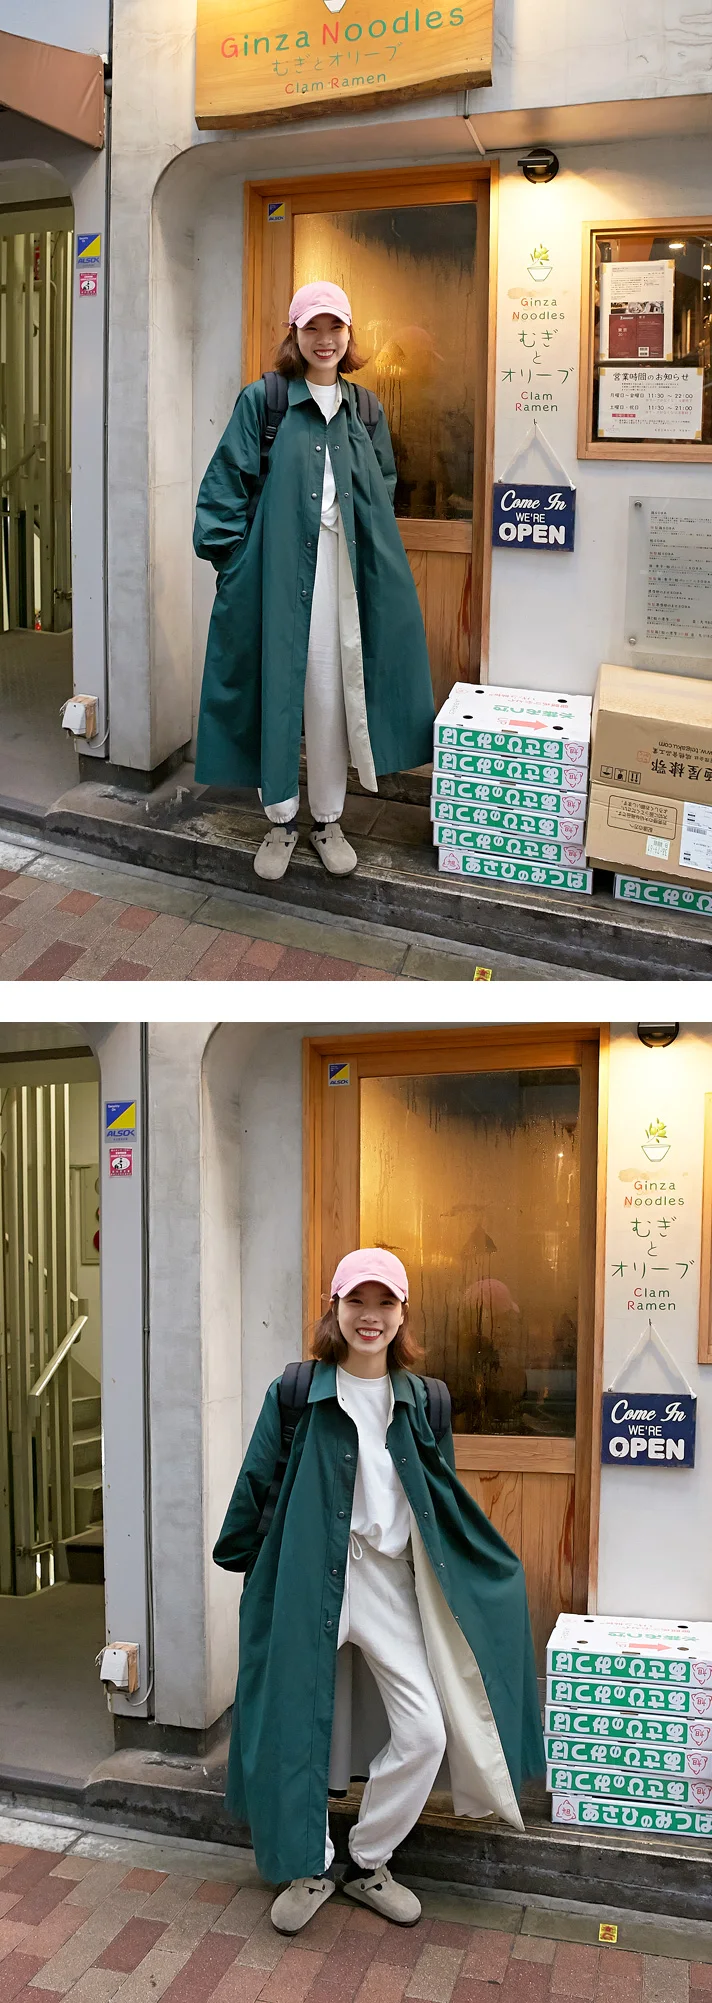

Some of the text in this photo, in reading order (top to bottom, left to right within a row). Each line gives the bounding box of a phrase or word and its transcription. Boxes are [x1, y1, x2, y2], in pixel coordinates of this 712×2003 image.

[221, 7, 465, 58] Ginza Noodles
[272, 42, 403, 76] むぎとオリーブ
[285, 73, 387, 94] Clam Ramen
[520, 298, 558, 307] Ginza
[512, 311, 565, 321] Noodles
[518, 329, 559, 348] むぎ
[533, 351, 542, 365] と
[501, 367, 575, 384] オリーブ
[613, 372, 689, 381] 営業時間のお知らせ
[521, 391, 553, 401] Clam
[515, 403, 558, 412] Ramen
[500, 490, 567, 511] Come In
[515, 512, 546, 523] WE'RE
[499, 522, 566, 545] OPEN
[441, 727, 560, 759] あさひのみつば
[441, 752, 559, 785] あさひのみつば
[439, 779, 557, 811] あさひのみつば
[438, 802, 555, 836] あさひのみつば
[441, 828, 558, 860] あさひのみつば
[465, 858, 584, 889] あさひのみつば
[107, 1129, 135, 1137] ALSOK
[634, 1181, 676, 1191] Ginza
[624, 1196, 685, 1206] Noodles
[630, 1216, 677, 1237] むぎ
[647, 1241, 658, 1257] と
[611, 1259, 695, 1279] オリーブ
[633, 1287, 670, 1298] Clam
[627, 1300, 676, 1311] Ramen
[611, 1399, 687, 1424] Come In
[628, 1424, 662, 1436] WE'RE
[609, 1436, 685, 1460] OPEN
[555, 1653, 687, 1682] あさひのみつば
[555, 1682, 686, 1711] あさひのみつば
[554, 1713, 685, 1742] あさひのみつば
[552, 1741, 683, 1771] あさひのみつば
[555, 1771, 685, 1801] あさひのみつば
[582, 1803, 712, 1833] あさひのみつば
